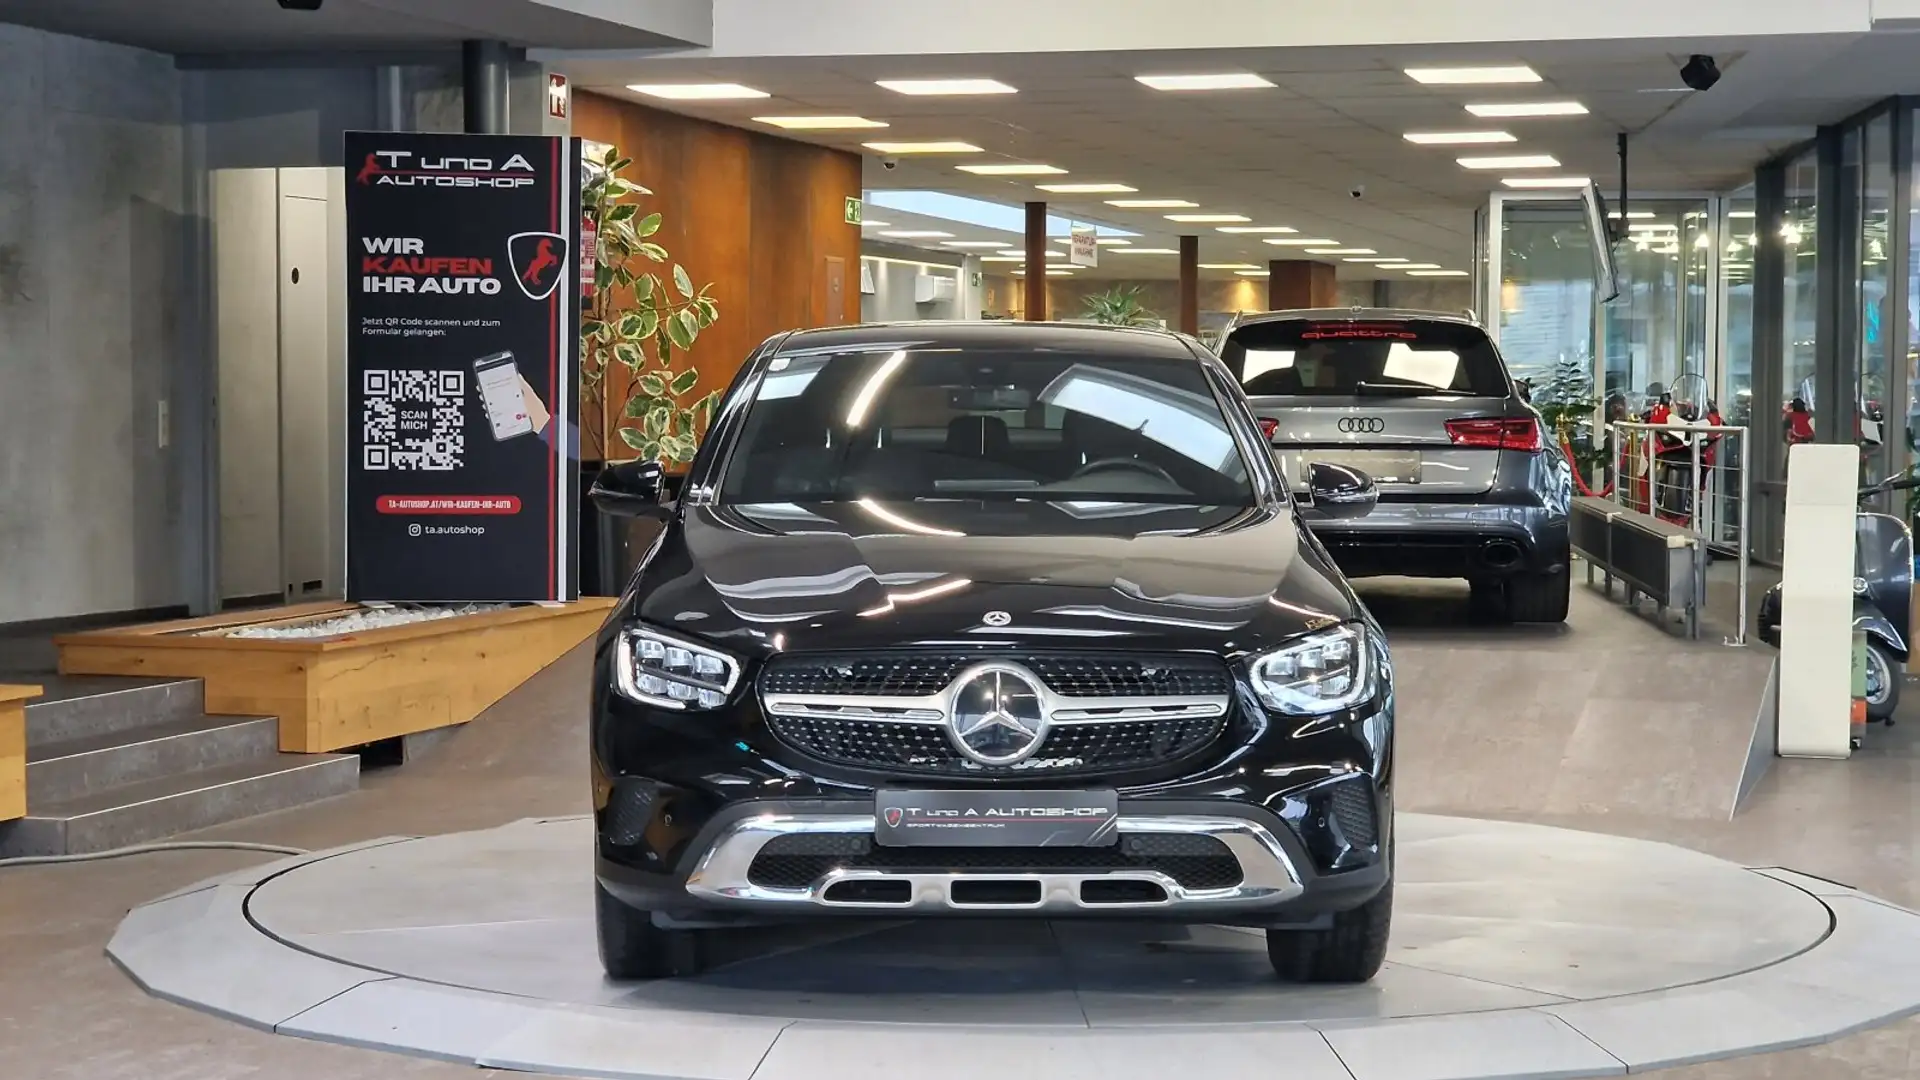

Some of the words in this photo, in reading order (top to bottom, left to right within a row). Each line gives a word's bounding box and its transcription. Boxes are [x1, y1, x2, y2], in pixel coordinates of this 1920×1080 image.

[376, 150, 412, 168] T
[500, 153, 535, 172] A
[376, 175, 535, 188] AUTOSHOP
[362, 237, 424, 255] WIR
[362, 256, 492, 275] KAUFEN
[363, 276, 416, 293] IHR
[419, 277, 501, 295] AUTO
[362, 317, 383, 326] Jetzt
[385, 317, 399, 327] QR
[400, 317, 423, 326] Code
[462, 318, 480, 327] und
[362, 327, 402, 335] Formular
[403, 328, 447, 338] gelangen:
[1301, 330, 1417, 339] quattro
[400, 410, 428, 420] SCAN
[400, 420, 428, 430] MICH
[424, 525, 485, 537] ta.autoshop
[906, 807, 922, 816] T
[964, 807, 979, 817] A
[985, 807, 1109, 817] AUTOSHOP
